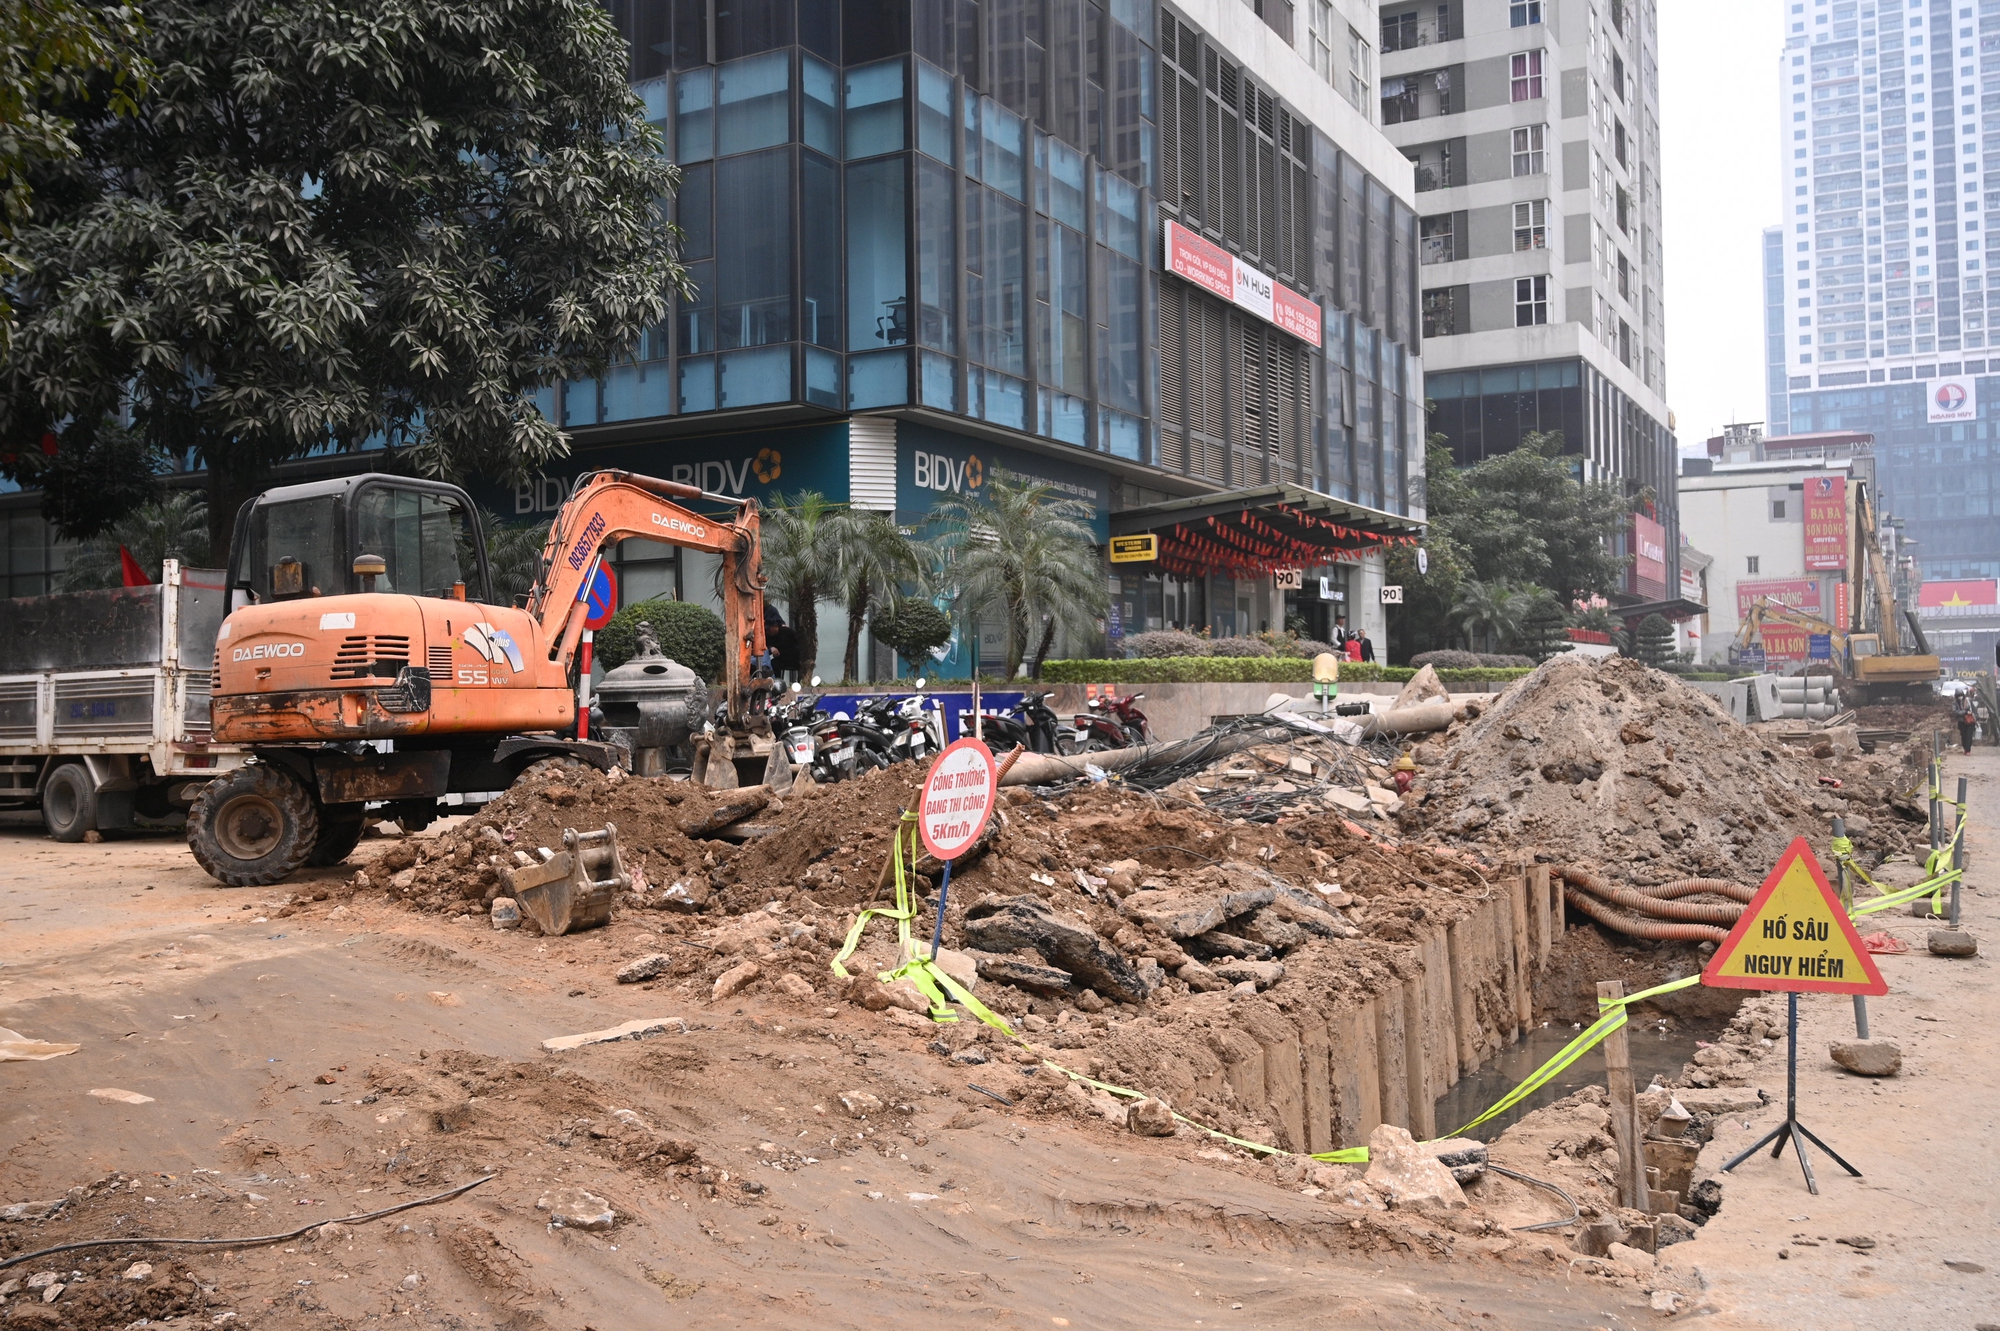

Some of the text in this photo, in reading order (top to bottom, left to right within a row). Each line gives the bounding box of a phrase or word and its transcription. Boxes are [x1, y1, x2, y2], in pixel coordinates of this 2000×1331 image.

[1215, 279, 1231, 297] SPACE
[1251, 277, 1271, 300] HUB
[672, 458, 753, 500] BIDV
[915, 450, 966, 494] BIDV
[1810, 507, 1841, 520] BA BA
[651, 512, 706, 538] DAEWOO
[1806, 523, 1821, 537] SƠN
[568, 512, 606, 571] 0936577933
[1277, 572, 1293, 585] 90
[1382, 589, 1396, 600] 90
[1740, 595, 1751, 609] BA
[232, 642, 305, 662] DAEWOO
[494, 637, 510, 648] plus
[1774, 638, 1786, 653] BA
[1788, 636, 1805, 653] SƠN
[458, 670, 489, 685] 55
[932, 766, 986, 792] CÔNG TRƯỜNG
[926, 792, 986, 816] ĐANG THI CÔNG
[932, 820, 971, 840] 5Km/h
[1763, 913, 1829, 941] HỐ SÂU
[1744, 949, 1844, 978] NGUY HIỂM
